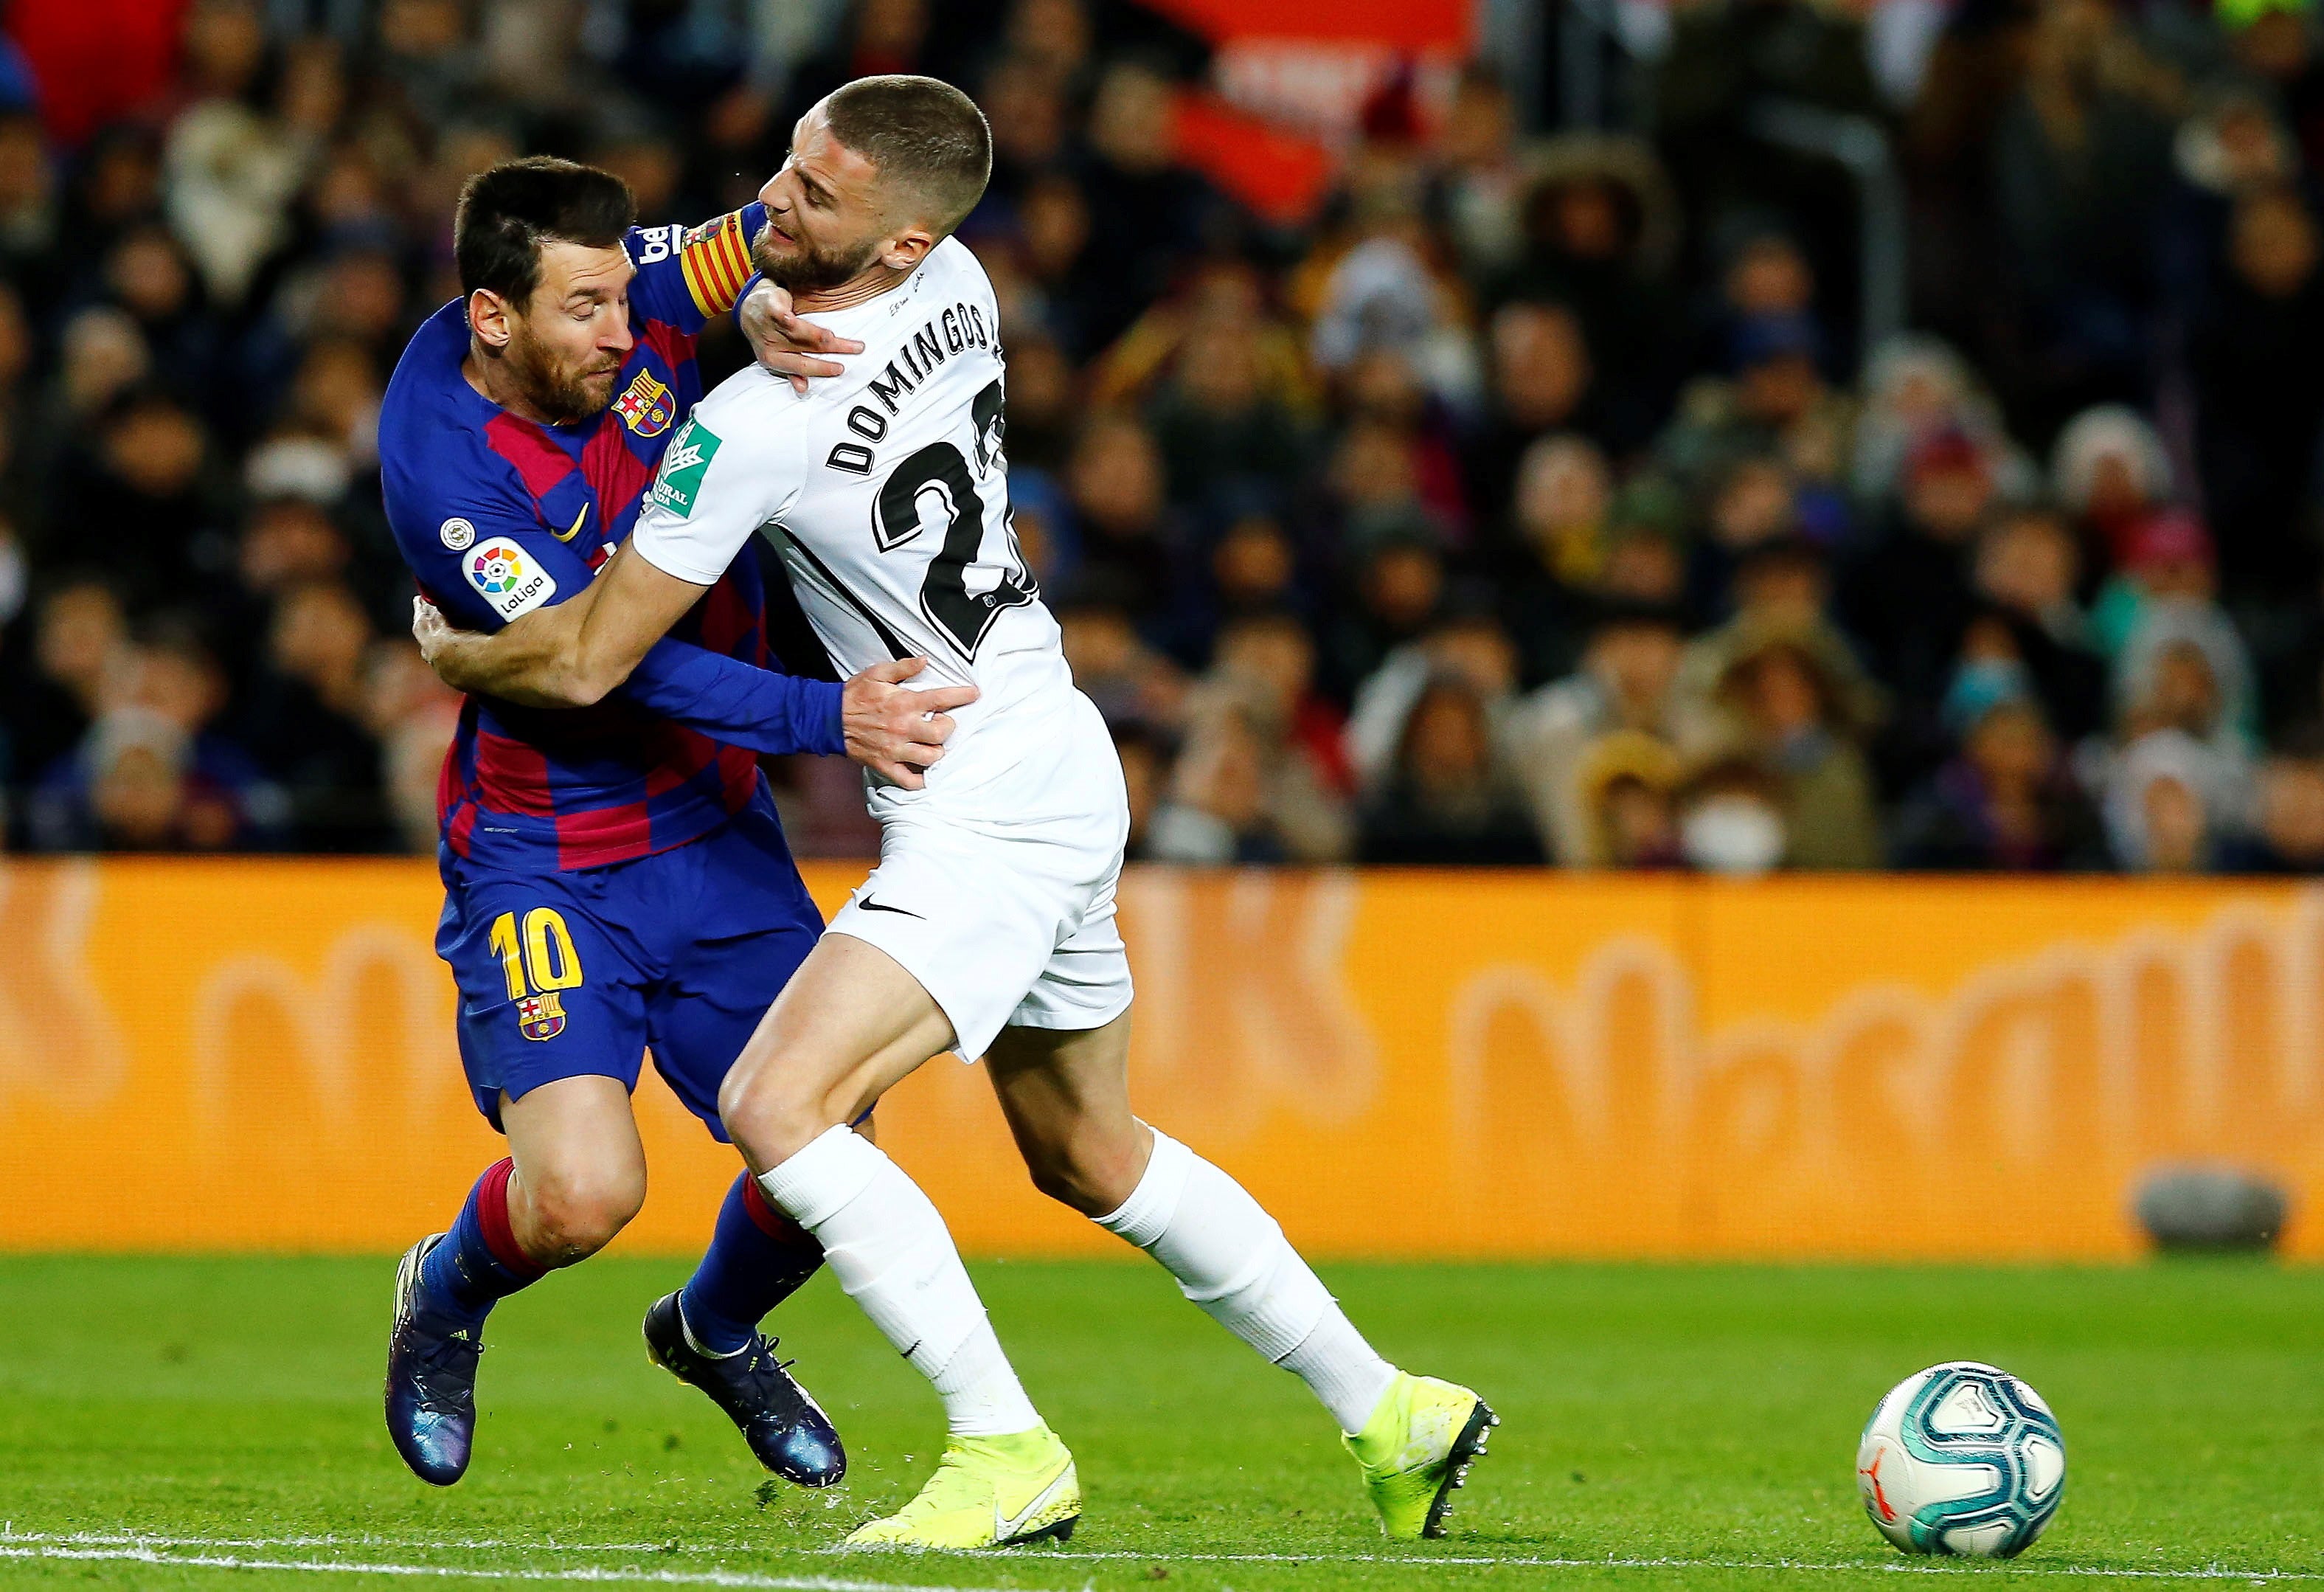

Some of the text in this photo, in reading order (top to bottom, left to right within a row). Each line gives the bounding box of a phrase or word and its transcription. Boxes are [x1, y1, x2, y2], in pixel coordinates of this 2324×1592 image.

[639, 396, 656, 416] FCB
[825, 302, 988, 476] DOMINGOS
[657, 480, 689, 506] URAL
[501, 576, 544, 613] LaLiga
[488, 907, 583, 1001] 10
